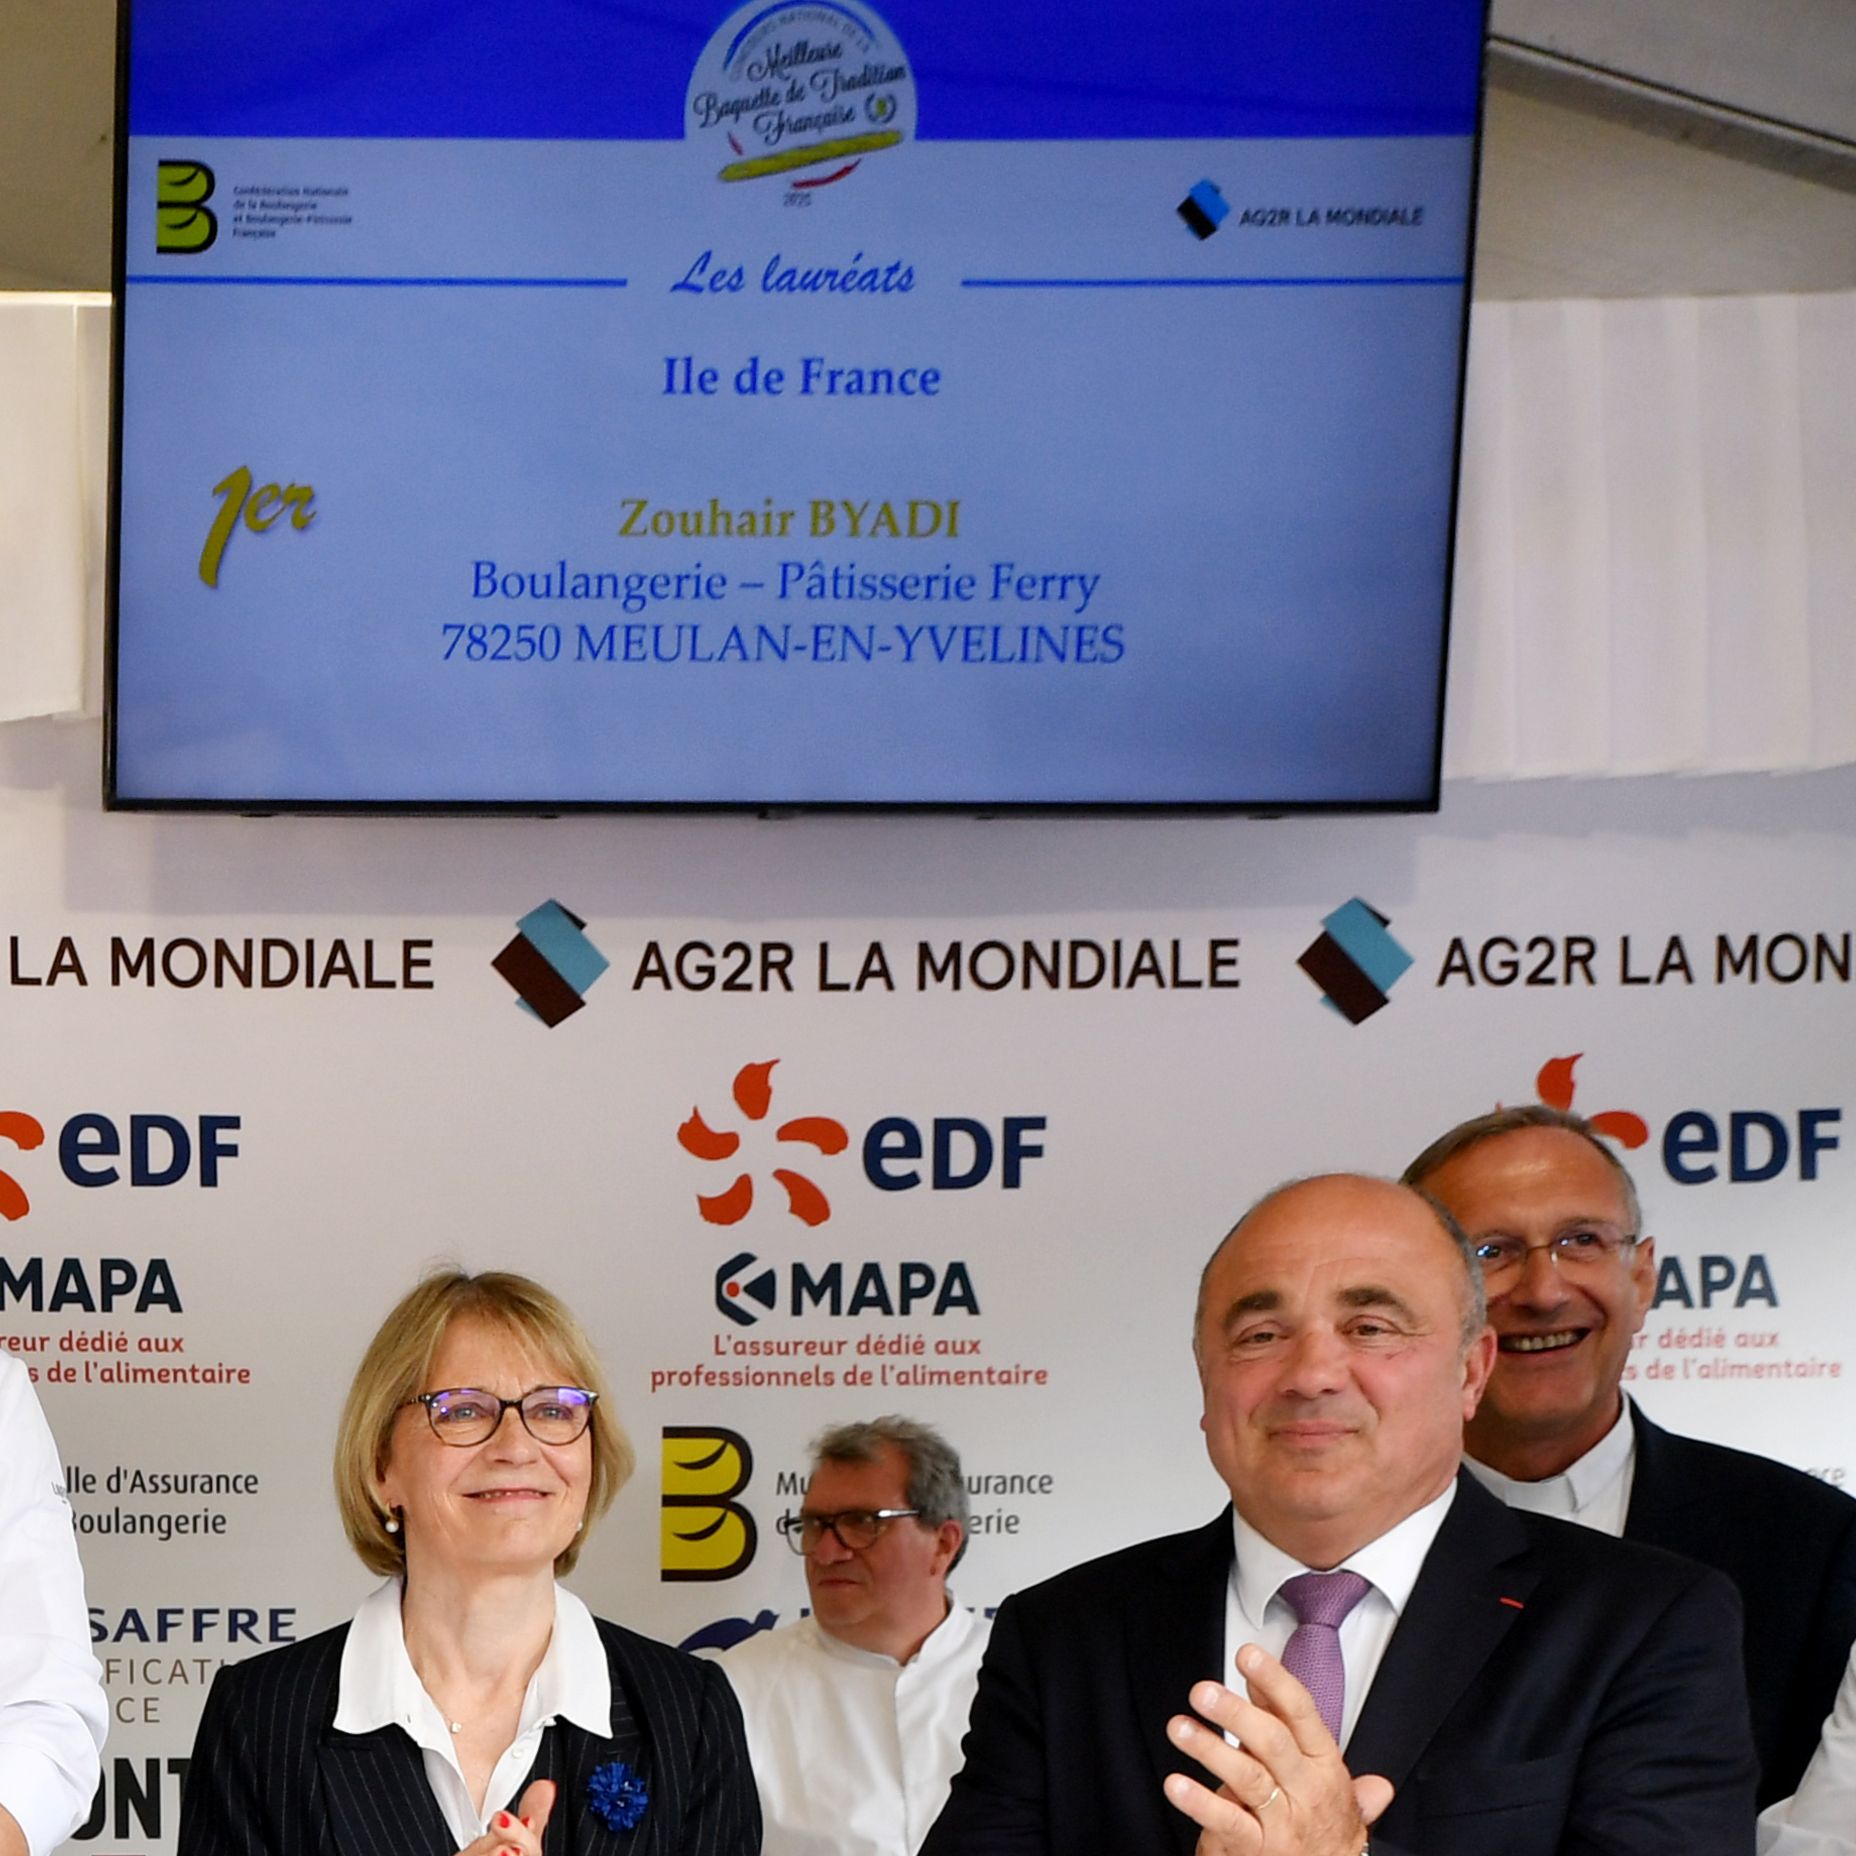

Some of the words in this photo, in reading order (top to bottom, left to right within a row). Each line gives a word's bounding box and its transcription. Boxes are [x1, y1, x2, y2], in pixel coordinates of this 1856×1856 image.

[1240, 209, 1290, 226] AG2R
[1295, 208, 1319, 226] LA
[1325, 206, 1424, 227] MONDIALE
[670, 250, 745, 294] Les
[761, 252, 916, 294] lauréats
[662, 357, 718, 395] Ile
[734, 356, 784, 396] de
[799, 358, 941, 396] France
[199, 465, 318, 588] 1er
[619, 497, 795, 538] Zouhair
[808, 500, 961, 538] BYADI
[472, 559, 728, 614] Boulangerie
[777, 559, 975, 601] Pâtisserie
[989, 562, 1101, 614] Ferry
[441, 623, 560, 662] 78250
[575, 624, 1126, 665] MEULAN-EN-YVELINES
[10, 936, 88, 987] LA
[111, 937, 434, 990] MONDIALE
[632, 940, 794, 993] AG2R
[818, 940, 895, 993] LA
[916, 938, 1241, 992] MONDIALE
[1437, 935, 1597, 987] AG2R
[1620, 934, 1694, 985] LA
[790, 1261, 981, 1317] MAPA
[1651, 1254, 1779, 1309] APA
[59, 1330, 128, 1352] dédié
[138, 1336, 184, 1353] aux
[714, 1334, 848, 1356] L'assureur
[856, 1333, 925, 1356] dédié
[934, 1338, 982, 1356] aux
[1658, 1327, 1726, 1350] dédié
[1734, 1331, 1780, 1349] aux
[47, 1360, 77, 1384] de
[84, 1360, 251, 1384] l'alimentaire
[650, 1364, 835, 1393] professionnels
[843, 1365, 873, 1387] de
[881, 1364, 1049, 1387] l'alimentaire
[1645, 1358, 1676, 1380] de
[1683, 1357, 1843, 1380] l'alimentaire
[106, 1466, 259, 1494] d'Assurance
[967, 1474, 1054, 1495] urance
[88, 1608, 296, 1644] SAFFRE
